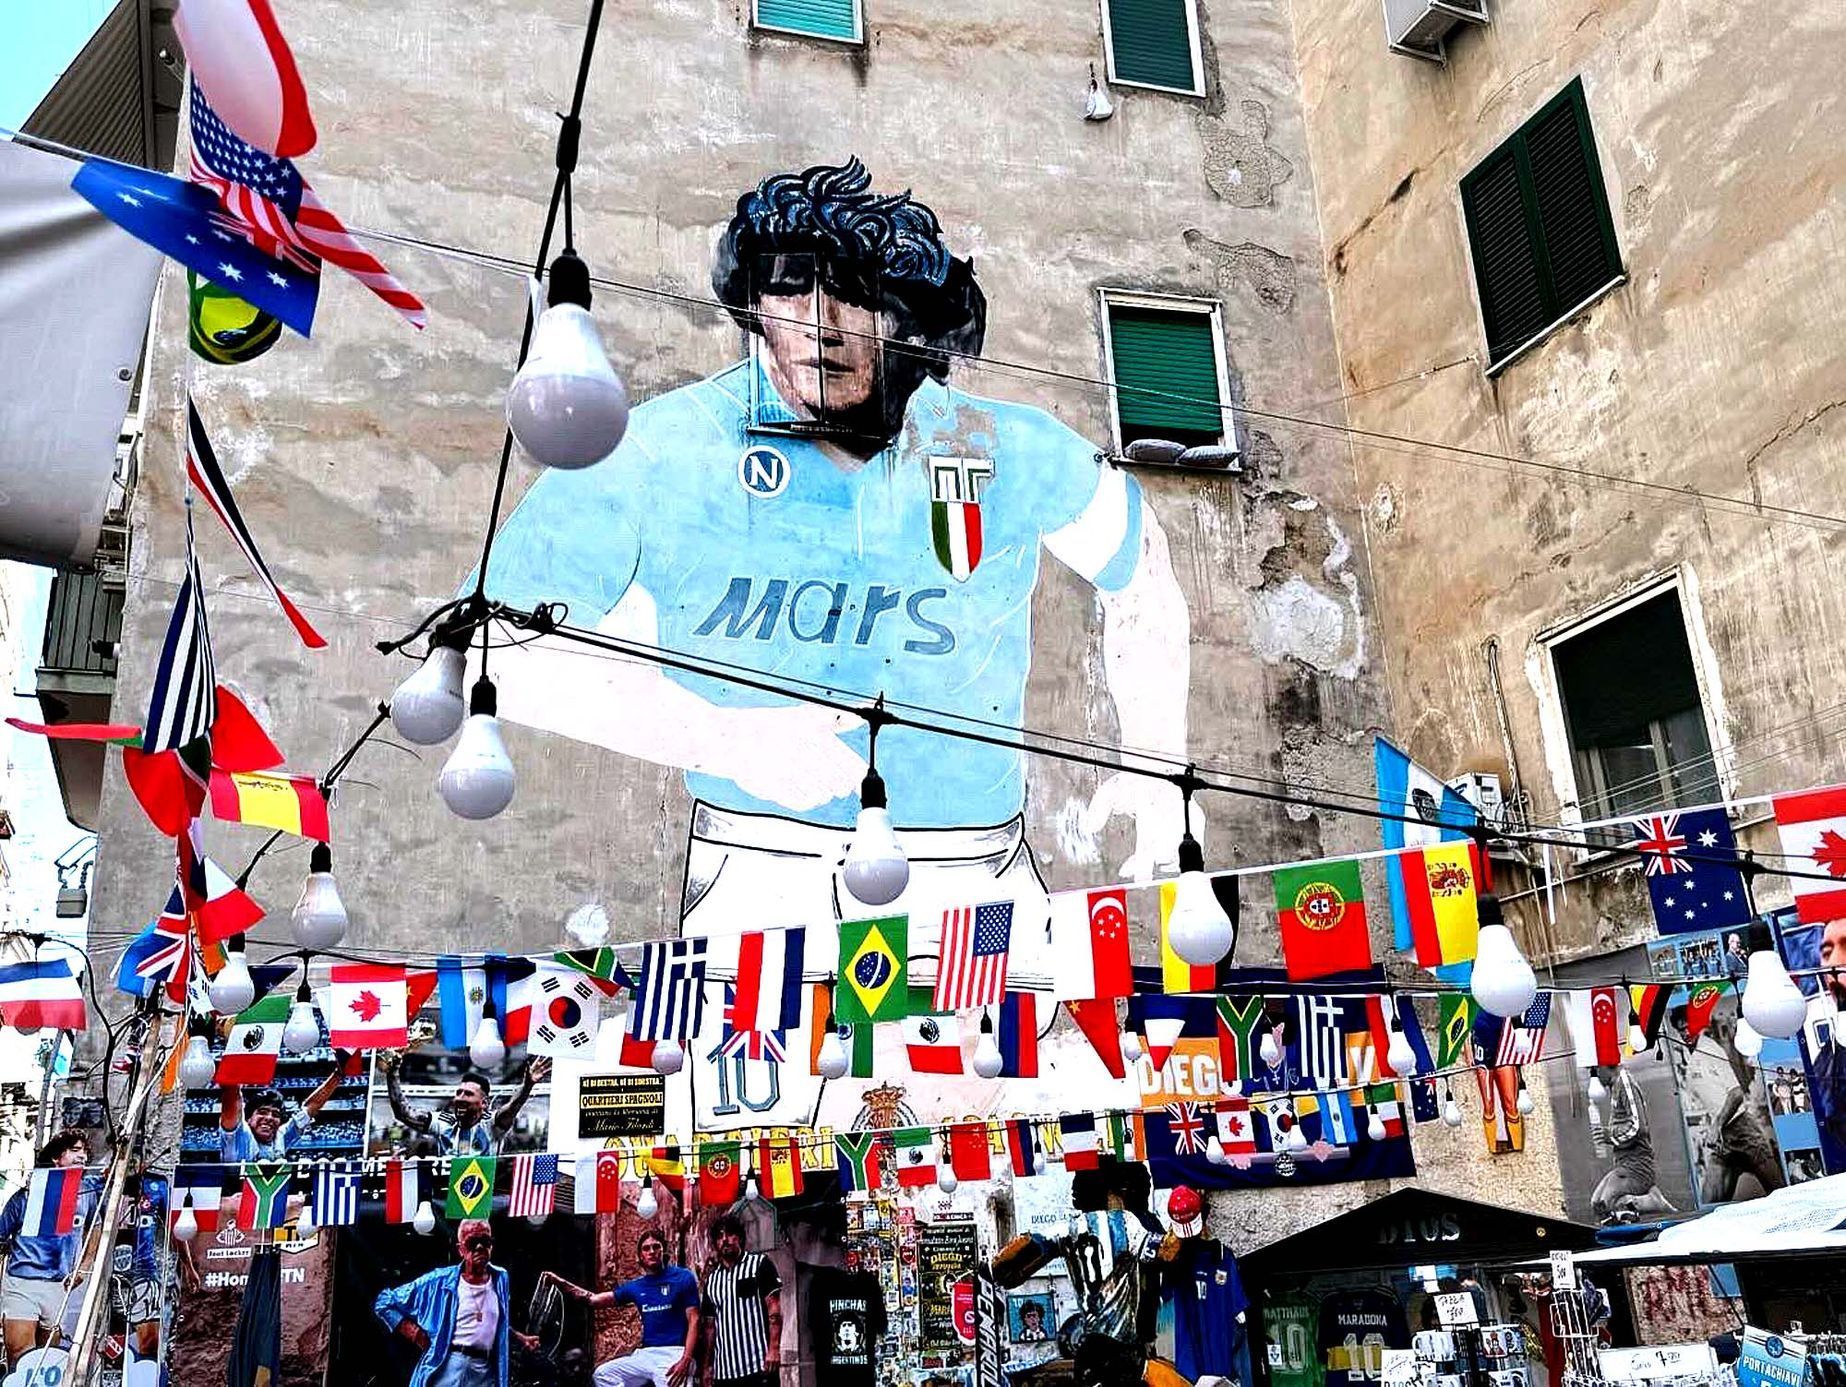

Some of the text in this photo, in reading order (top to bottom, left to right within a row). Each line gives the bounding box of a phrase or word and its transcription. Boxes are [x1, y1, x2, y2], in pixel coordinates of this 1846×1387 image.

[748, 455, 779, 489] N
[693, 577, 955, 655] Mars
[582, 1093, 663, 1107] QUARTIERI SPAGNOLI
[1338, 1314, 1387, 1326] MARADONA
[1743, 1354, 1800, 1387] PORTACHIAVI
